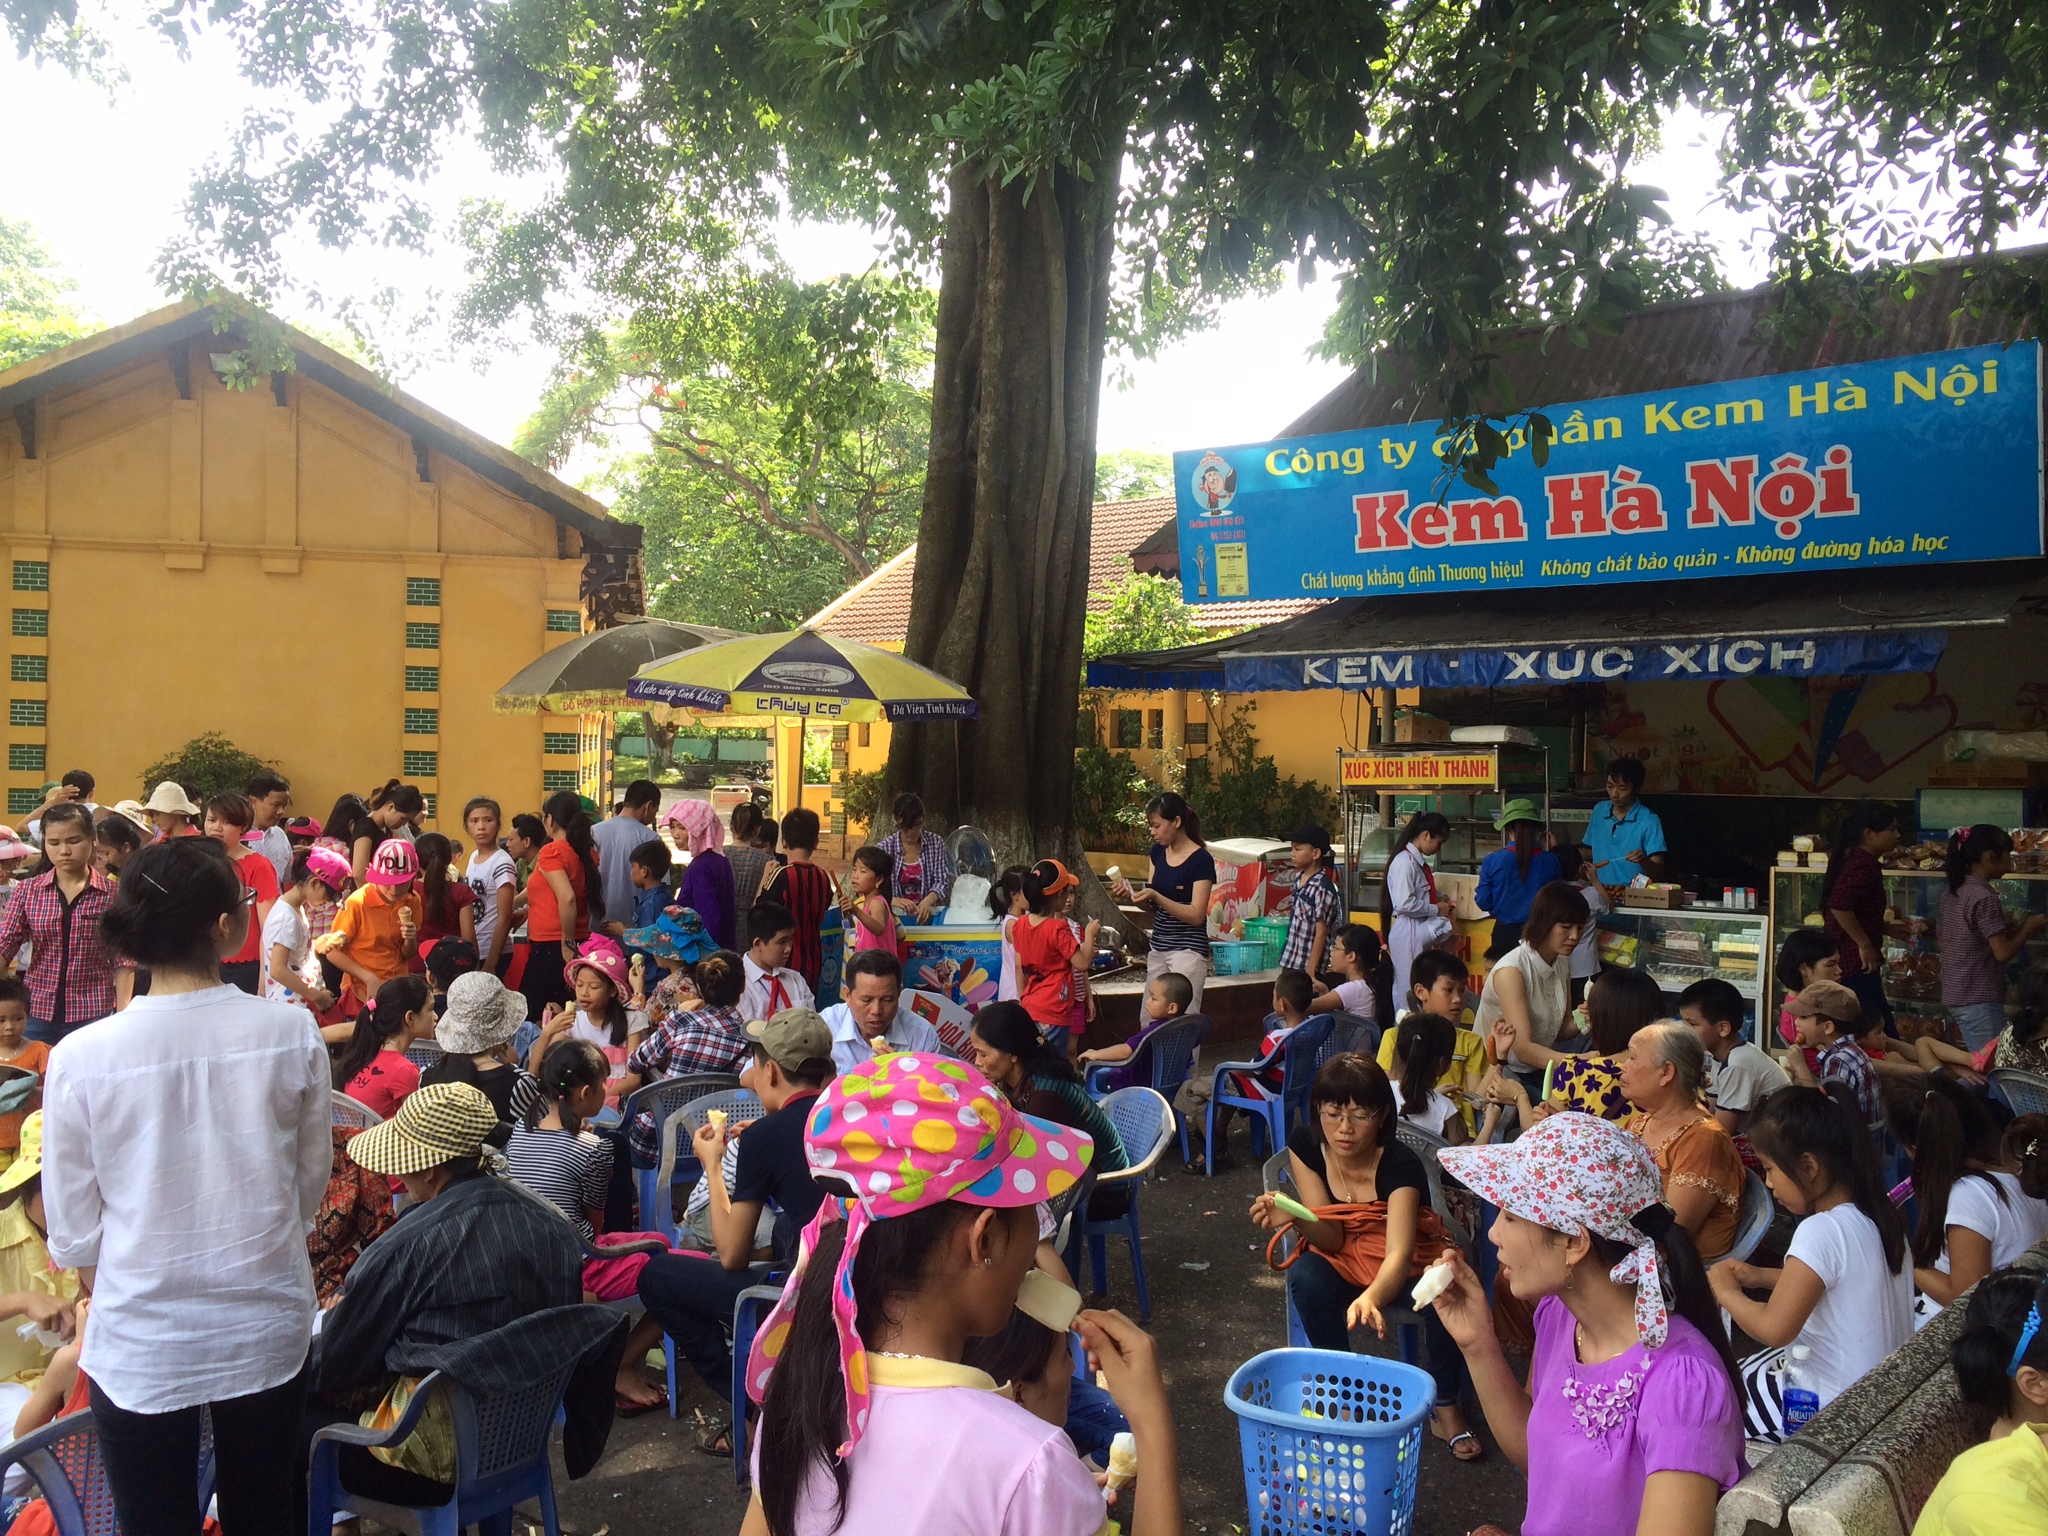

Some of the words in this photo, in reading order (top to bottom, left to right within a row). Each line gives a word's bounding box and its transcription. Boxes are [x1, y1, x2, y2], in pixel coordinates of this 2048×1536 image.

[1265, 446, 1364, 476] Công
[1379, 437, 1417, 469] ty
[1643, 397, 1764, 435] Kem
[1788, 378, 1867, 417] Hà
[1893, 359, 1998, 406] Nội
[1352, 489, 1529, 554] Kem
[1545, 464, 1668, 541] Hà
[1684, 443, 1860, 541] Nội
[1301, 569, 1328, 590] Chất
[1330, 570, 1364, 592] lượng
[1366, 564, 1404, 588] khẳng
[1408, 563, 1436, 585] định
[1438, 562, 1487, 584] Thương
[1490, 559, 1525, 579] hiệu!
[1540, 559, 1591, 579] Không
[1596, 552, 1634, 574] chất
[1636, 551, 1668, 571] bảo
[1673, 548, 1718, 572] quản
[1735, 544, 1796, 565] Không
[1801, 539, 1862, 561] đường
[1867, 535, 1905, 555] hóa
[1910, 533, 1949, 556] học
[1302, 654, 1414, 685] KEM
[1659, 637, 1817, 674] XÍCH
[892, 703, 905, 715] Đá
[906, 703, 925, 715] Viên
[926, 702, 945, 714] Tinh
[1344, 758, 1370, 780] XÚC
[1373, 757, 1404, 778] XÍCH
[1443, 756, 1489, 778] THÀNH
[378, 853, 407, 870] YOU
